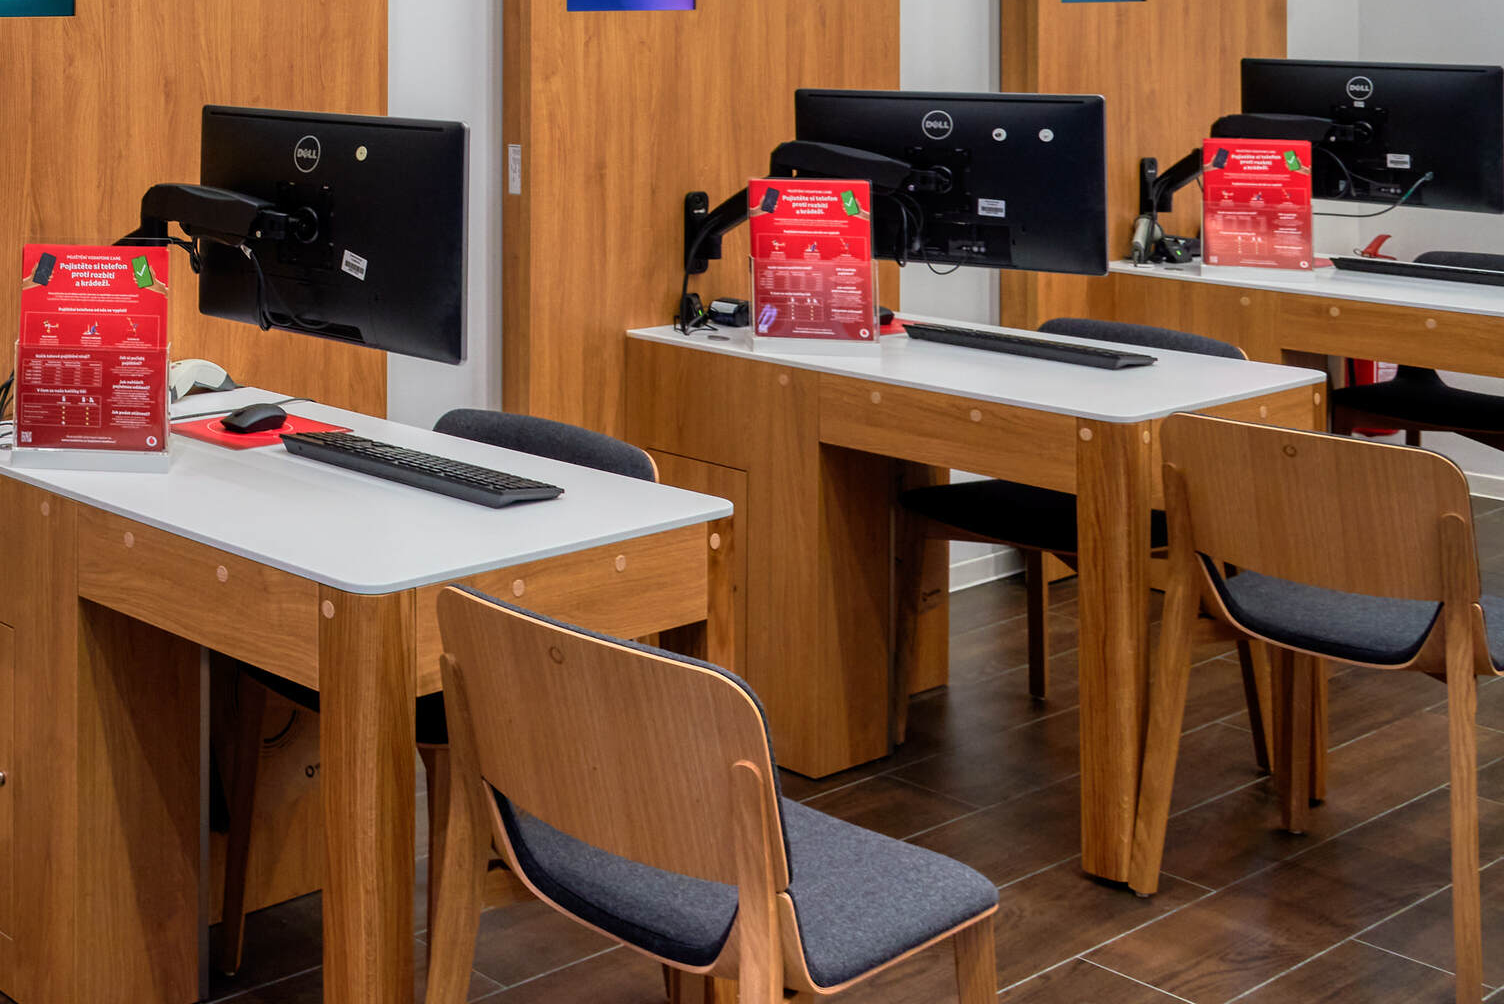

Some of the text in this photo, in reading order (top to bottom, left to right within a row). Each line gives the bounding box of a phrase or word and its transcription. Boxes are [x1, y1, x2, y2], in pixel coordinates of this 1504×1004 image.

[1349, 84, 1370, 92] DELL
[926, 120, 950, 129] DELL
[297, 148, 317, 159] DELL
